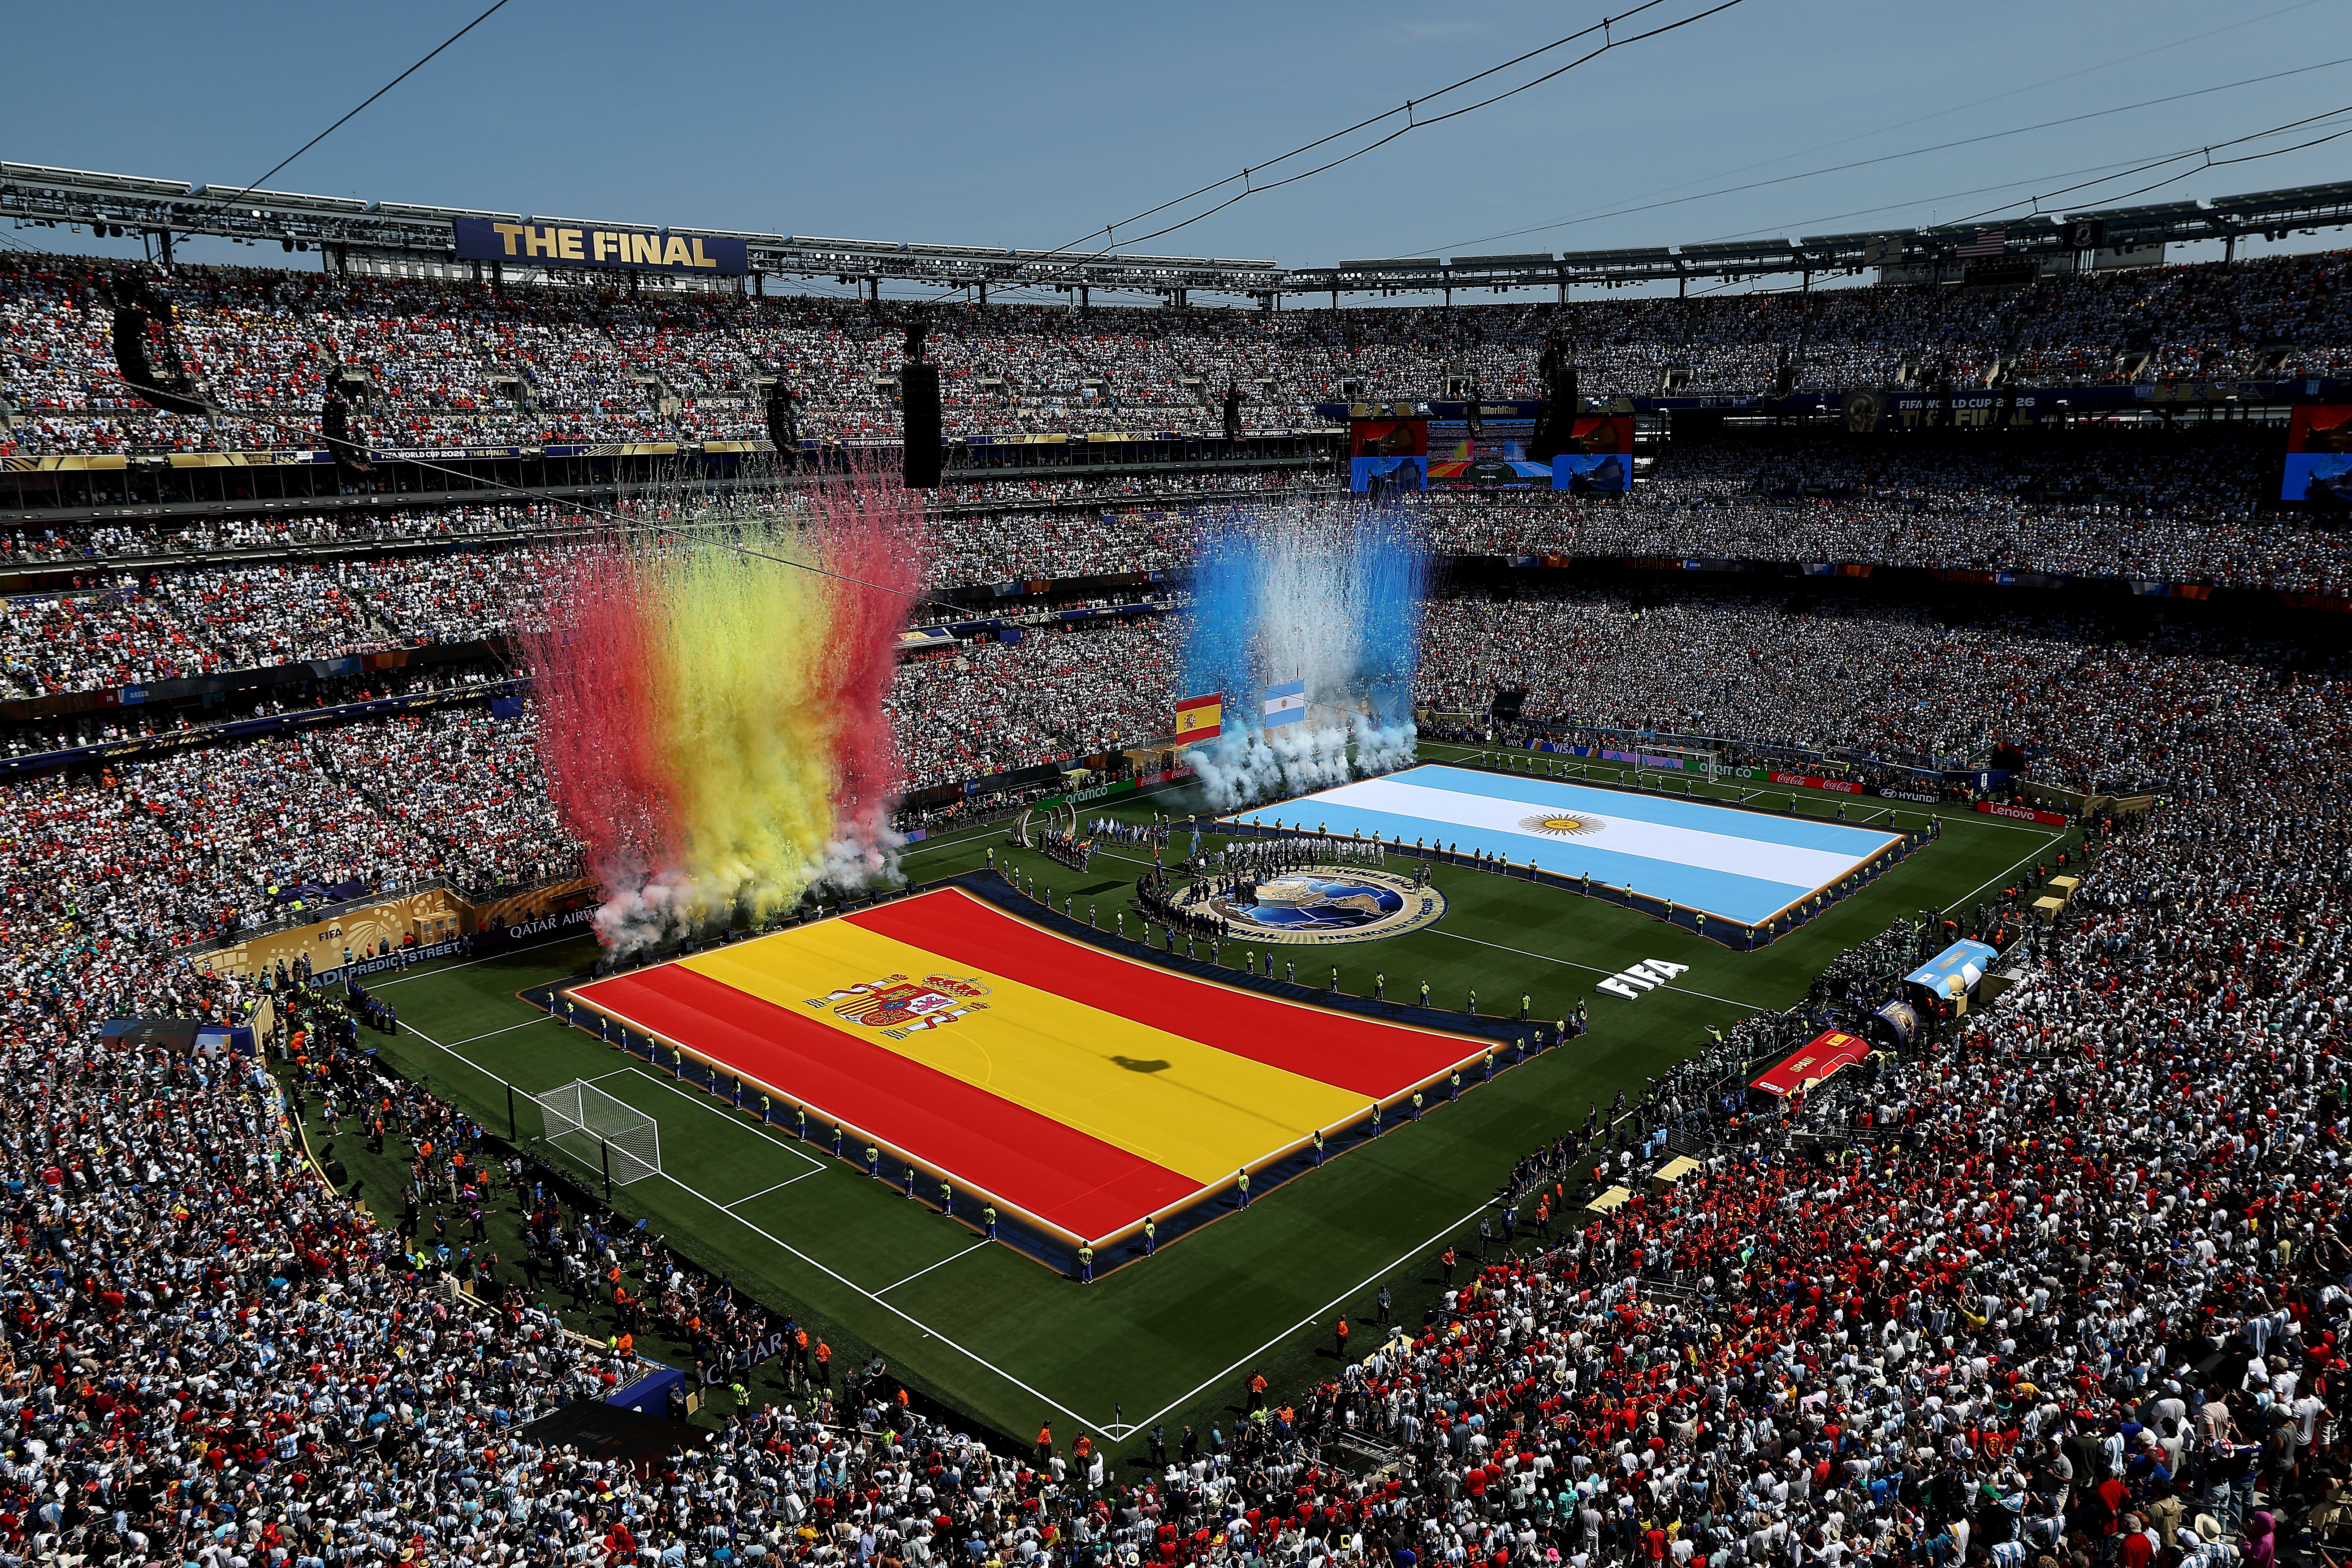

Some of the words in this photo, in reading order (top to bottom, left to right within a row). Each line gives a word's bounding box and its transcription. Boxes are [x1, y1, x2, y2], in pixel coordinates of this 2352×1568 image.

[493, 223, 585, 259] THE
[593, 231, 717, 268] FINAL
[1683, 560, 1688, 568] V
[1149, 572, 1153, 581] V
[1996, 574, 2001, 583] V
[117, 689, 125, 703] V
[1553, 743, 1575, 755] VISA
[1066, 786, 1107, 803] aramco
[1141, 773, 1161, 786] Coca-Cola
[1172, 766, 1190, 779] Coca-Cola
[1699, 763, 1752, 779] aramco
[1777, 773, 1805, 786] Coca-Cola
[1823, 780, 1852, 793] Coca-Cola
[964, 782, 968, 793] V
[1990, 804, 2035, 820] Lenovo
[936, 825, 954, 834] NEW
[955, 819, 977, 829] YORK
[978, 815, 995, 824] NEW
[997, 807, 1025, 820] JERSEY
[510, 917, 557, 938] QATAR
[563, 907, 601, 925] AIRW
[1356, 923, 1407, 937] WORLD
[1404, 915, 1424, 925] CUP
[1418, 898, 1434, 915] 2026
[318, 928, 343, 942] FIFA
[309, 969, 344, 988] ADI
[1596, 958, 1689, 1000] FIFA
[1789, 1056, 1817, 1072] SPAIN
